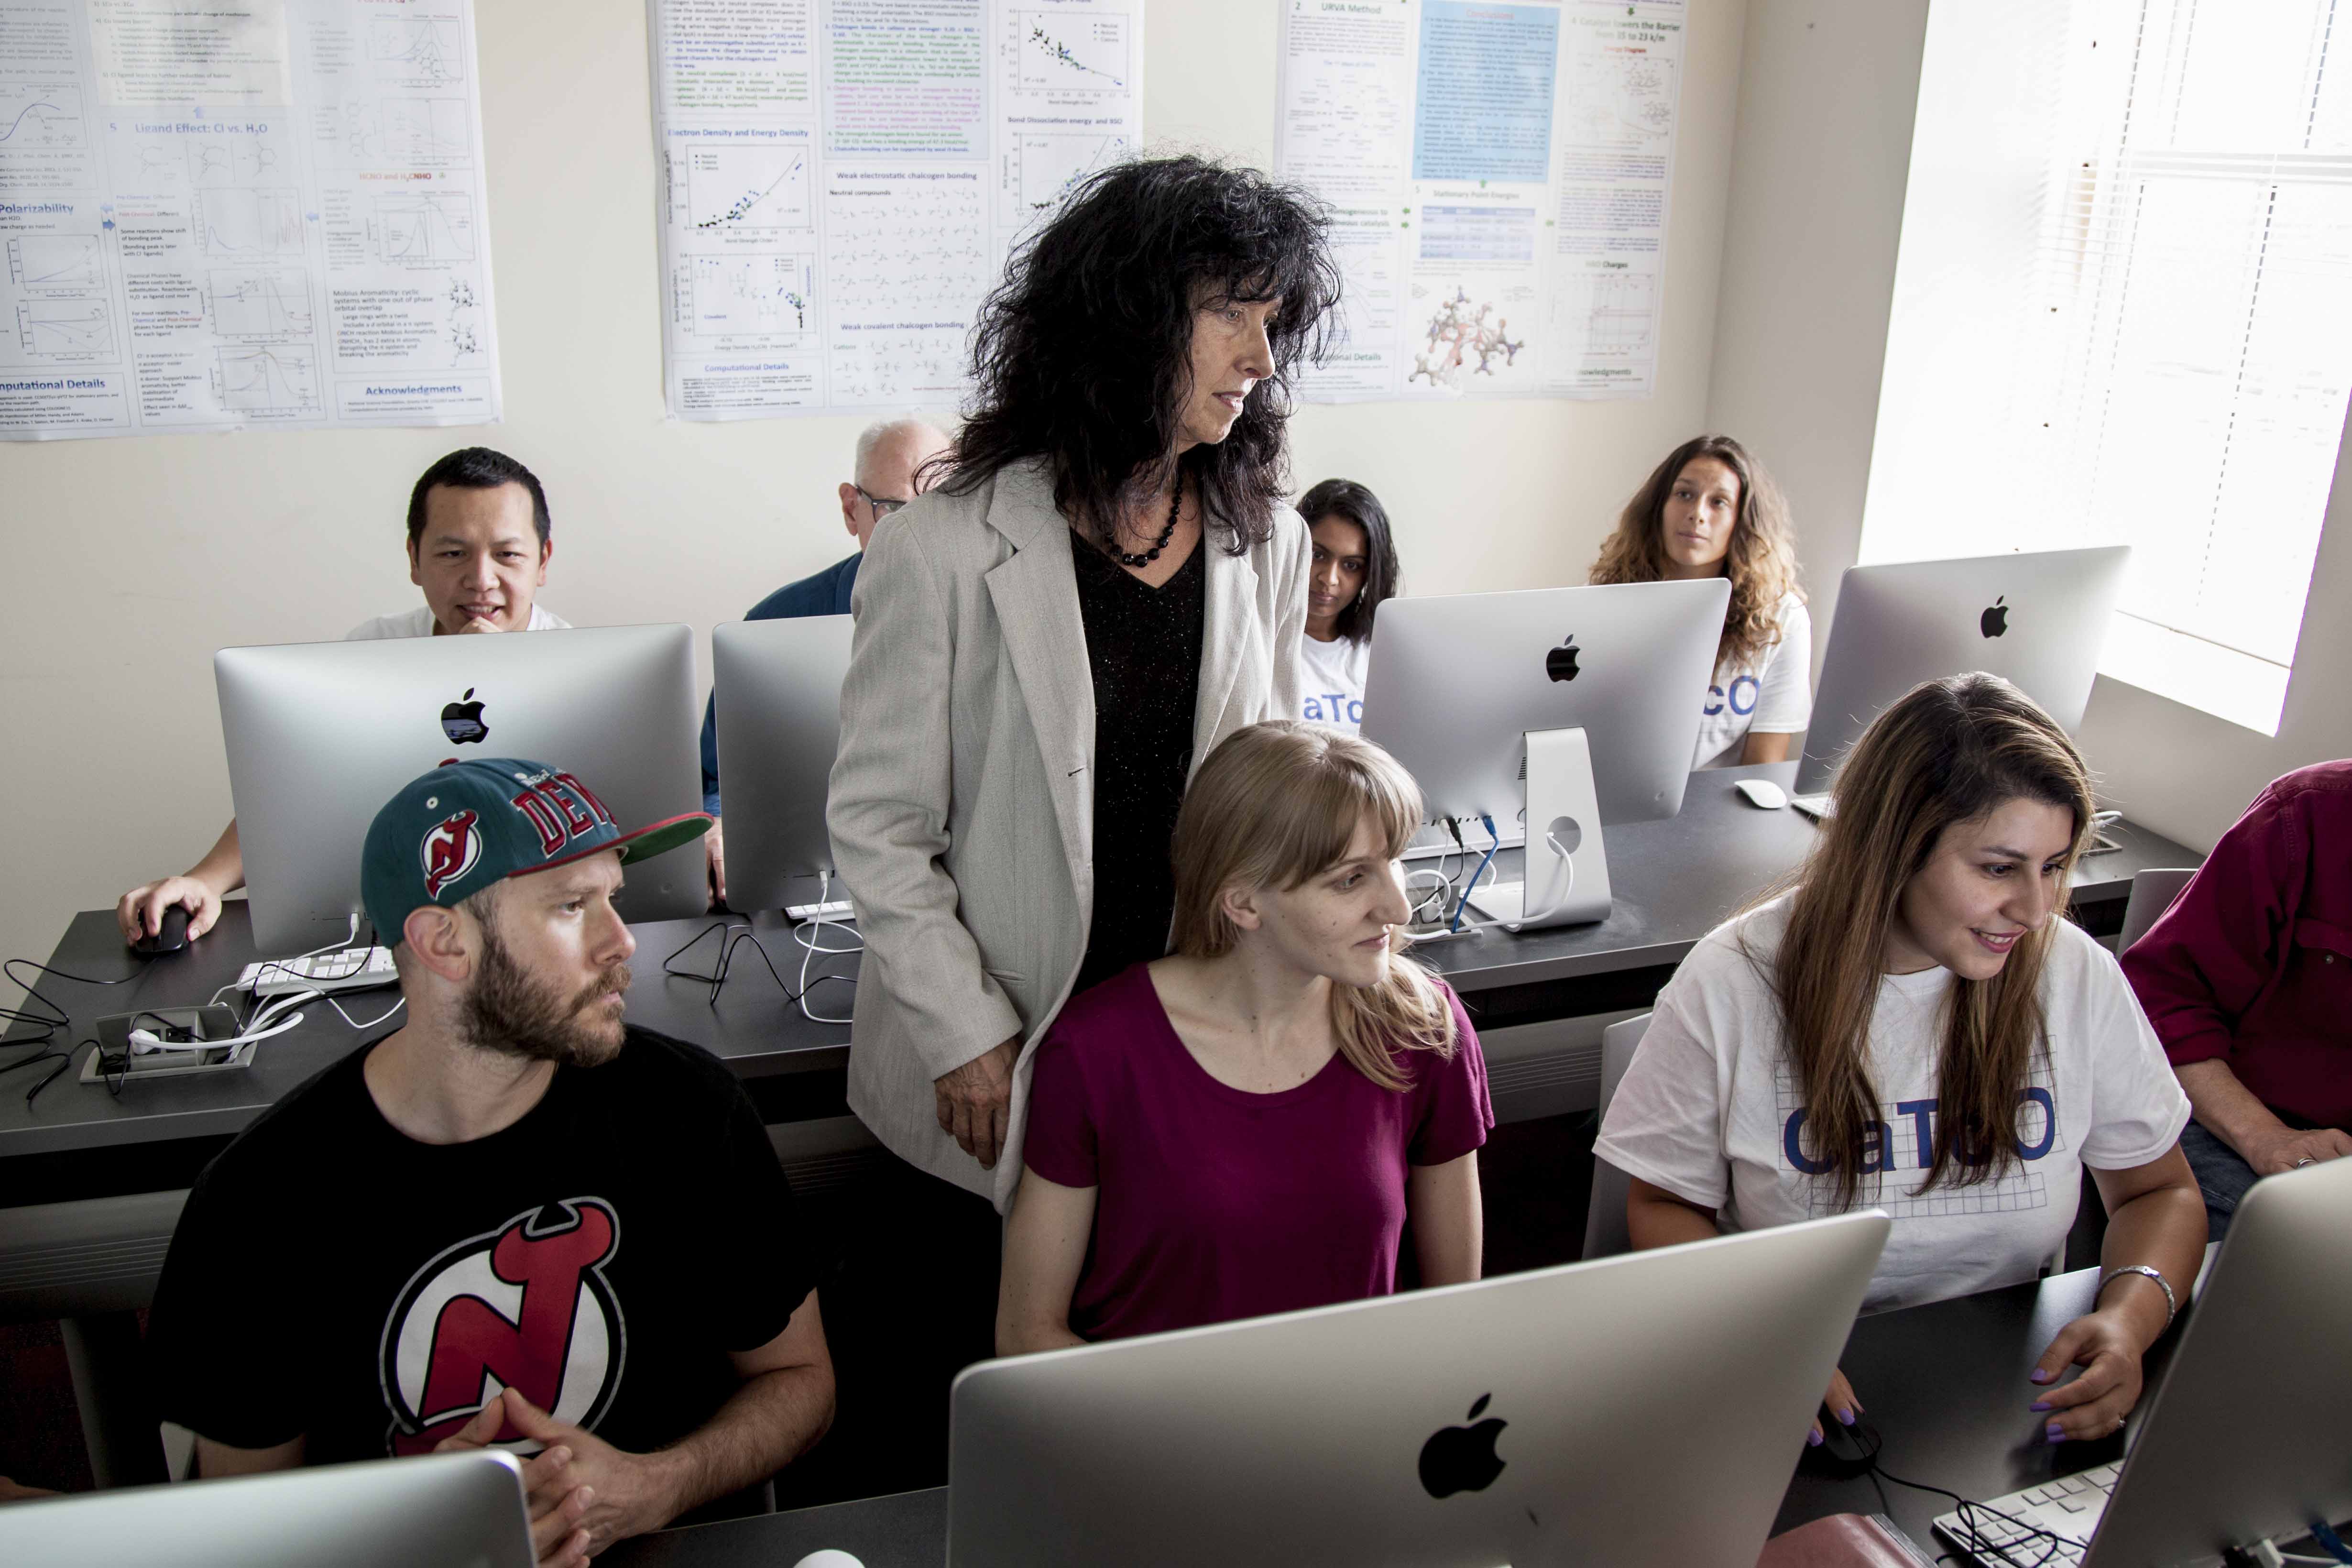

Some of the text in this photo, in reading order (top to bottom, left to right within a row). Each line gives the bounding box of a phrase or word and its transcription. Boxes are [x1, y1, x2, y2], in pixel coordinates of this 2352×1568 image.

[1348, 5, 1381, 13] Method
[1641, 21, 1654, 29] the
[135, 123, 173, 134] Ligand
[175, 123, 211, 133] Effect:
[702, 129, 732, 138] Density
[751, 129, 777, 138] Energy
[779, 129, 809, 138] Density
[908, 172, 945, 180] chalcogen
[947, 171, 977, 180] bonding
[1433, 190, 1469, 198] Stationary
[1491, 191, 1520, 200] Energies
[0, 203, 74, 216] Polarizability
[840, 321, 965, 330] Weak covalent chalcogen bonding
[704, 363, 761, 372] Computational
[1577, 367, 1632, 376] nowledgments
[66, 378, 106, 390] Details
[365, 384, 462, 396] Acknowledgments
[510, 773, 621, 859] DEV
